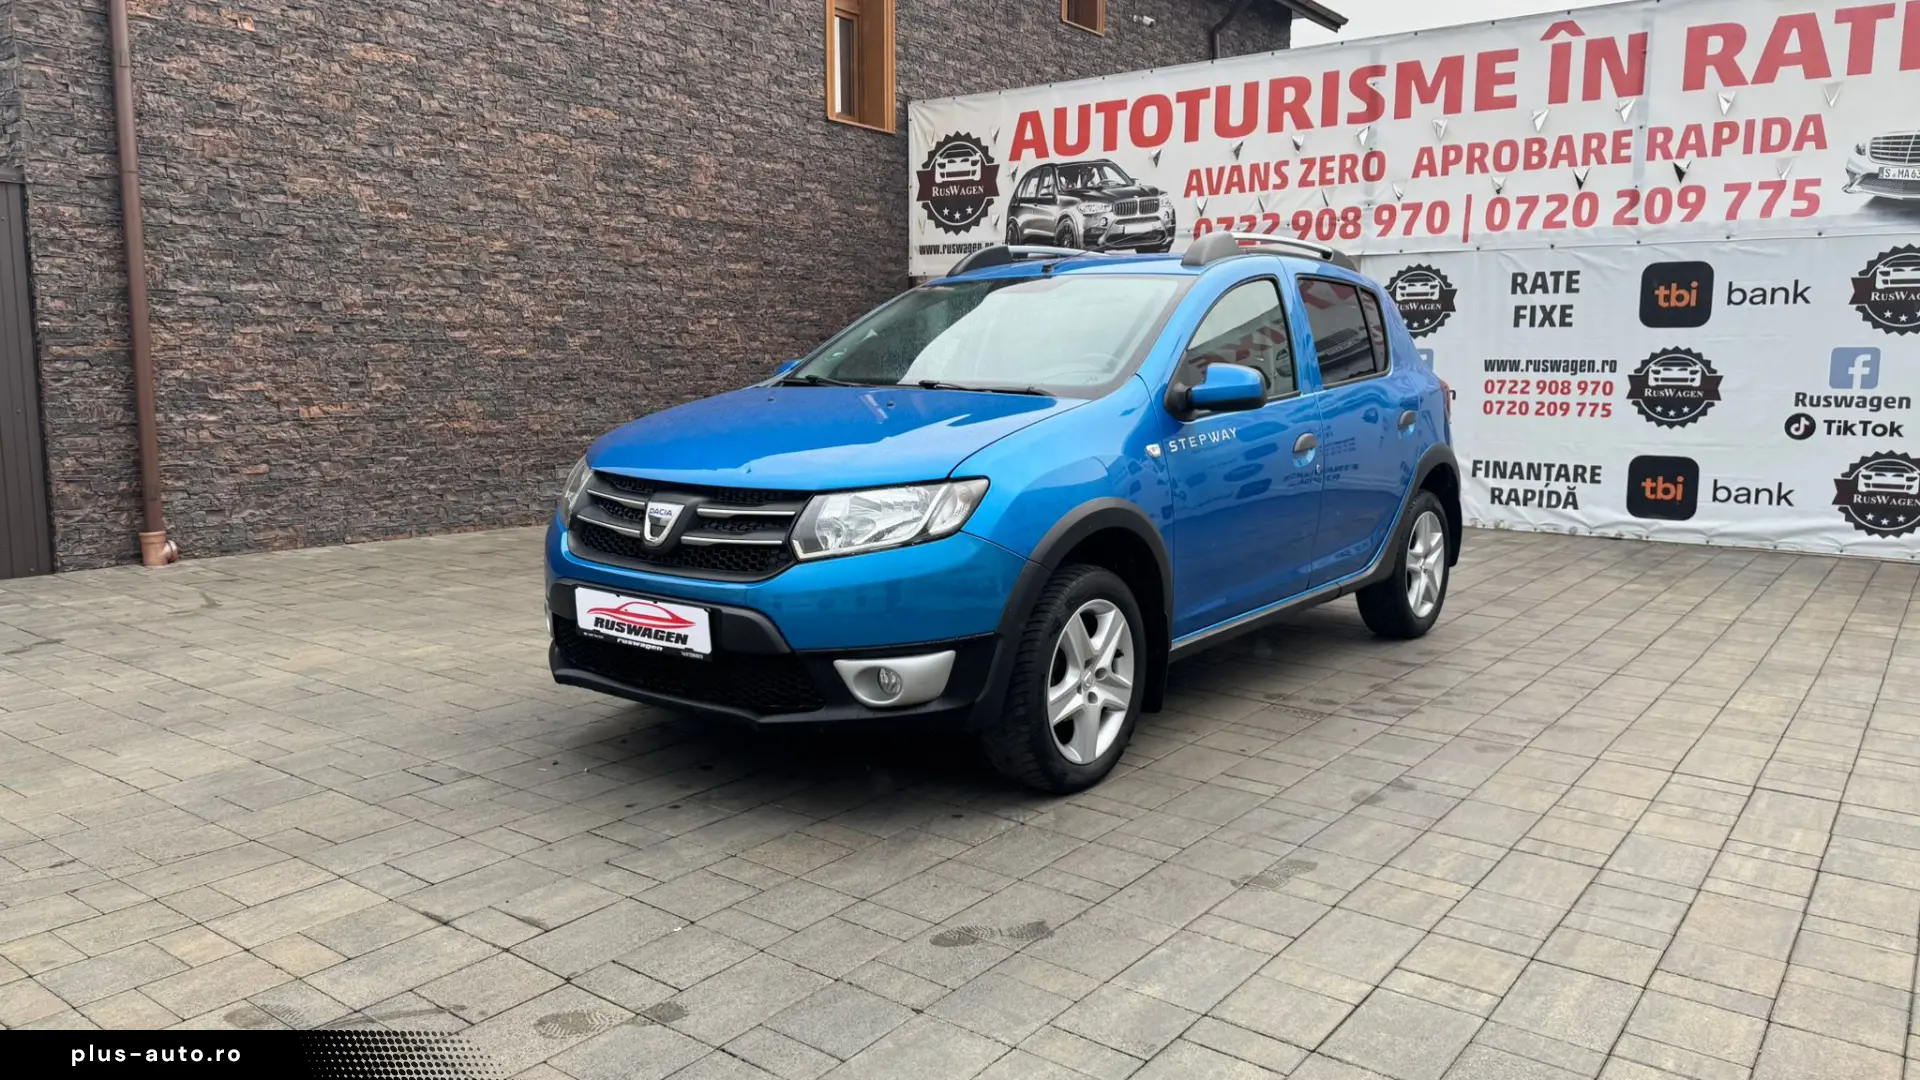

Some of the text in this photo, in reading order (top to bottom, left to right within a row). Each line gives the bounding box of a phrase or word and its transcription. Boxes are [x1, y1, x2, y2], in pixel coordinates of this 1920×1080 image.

[1008, 49, 1519, 162] AUTOTURISME
[1543, 20, 1648, 105] ÎN
[1184, 114, 1828, 199] AVANS ZERO APROBARE RAPIDA
[1291, 206, 1363, 242] 908
[1374, 200, 1451, 238] 970
[1485, 191, 1600, 232] 0720
[1613, 184, 1707, 226] 209
[1724, 178, 1821, 221] 775
[1510, 270, 1581, 295] RATE
[1654, 281, 1698, 307] tbi
[1726, 279, 1811, 306] bank
[1513, 304, 1574, 328] FIXE
[1484, 359, 1618, 375] www.ruswagen.ro
[1484, 379, 1614, 397] 0722 908 970
[1483, 399, 1612, 418] 0720 209 775
[1794, 391, 1912, 413] Ruswagen
[1169, 427, 1237, 452] STEPWAY
[1823, 419, 1904, 438] TikTok
[1490, 485, 1579, 511] RAPIDĂ
[1641, 475, 1684, 501] tbi
[1711, 478, 1794, 507] bank
[649, 507, 673, 516] DACIA
[594, 617, 689, 645] RUSWAGEN
